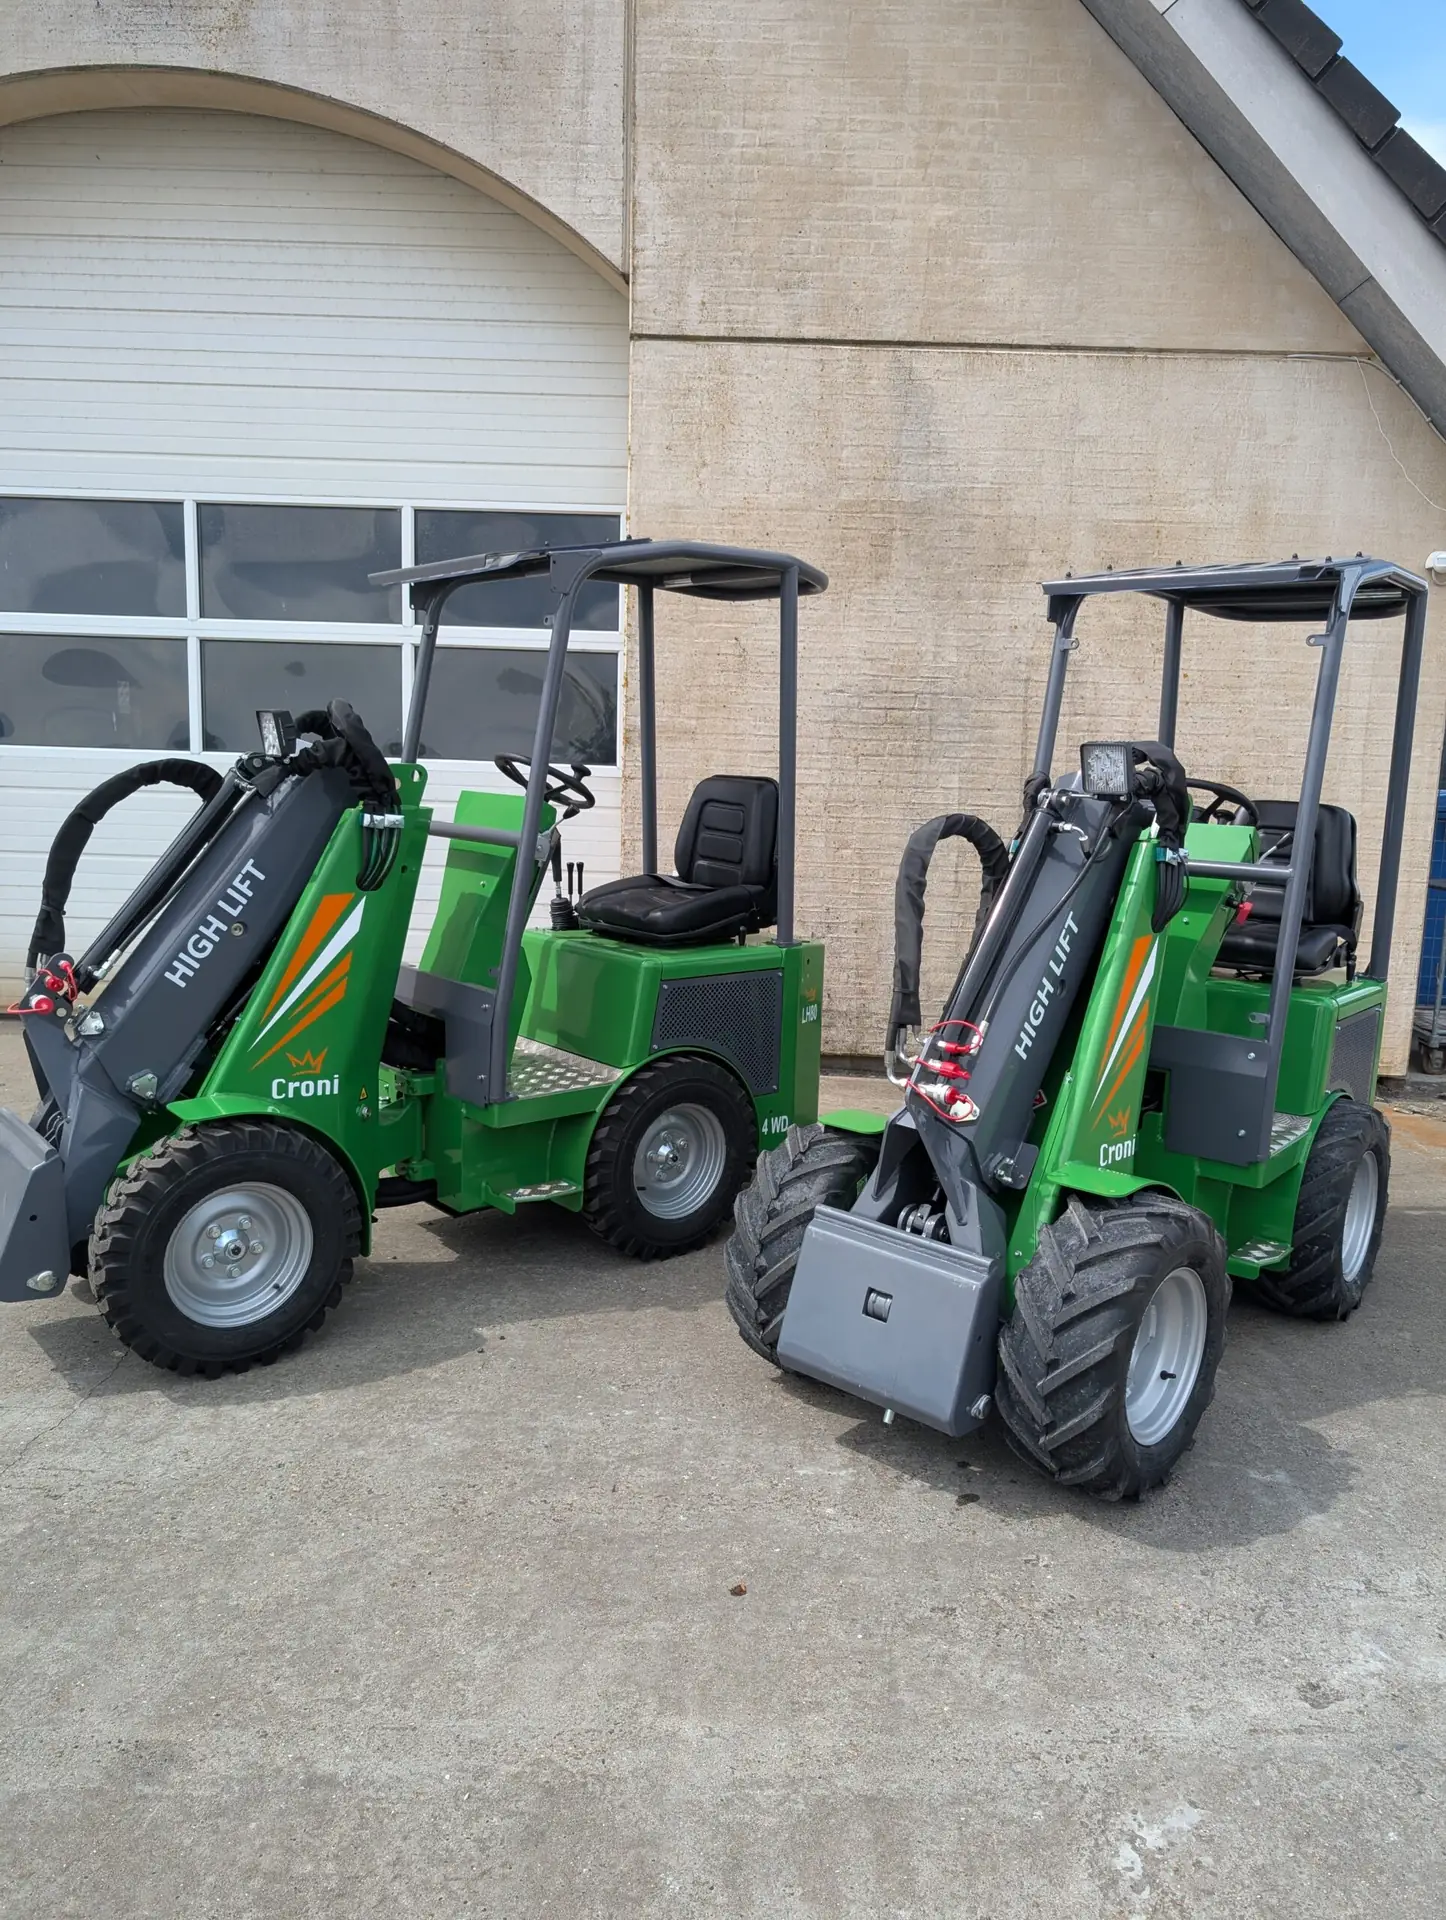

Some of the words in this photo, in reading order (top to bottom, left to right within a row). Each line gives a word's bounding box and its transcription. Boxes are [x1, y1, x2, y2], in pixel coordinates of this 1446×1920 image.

[164, 914, 228, 988] HIGH
[217, 858, 266, 917] LIFT
[1014, 976, 1054, 1061] HIGH
[1049, 911, 1079, 977] LIFT
[271, 1074, 339, 1100] Croni
[761, 1118, 768, 1135] 4
[771, 1115, 788, 1134] WD
[1099, 1133, 1136, 1167] Croni
